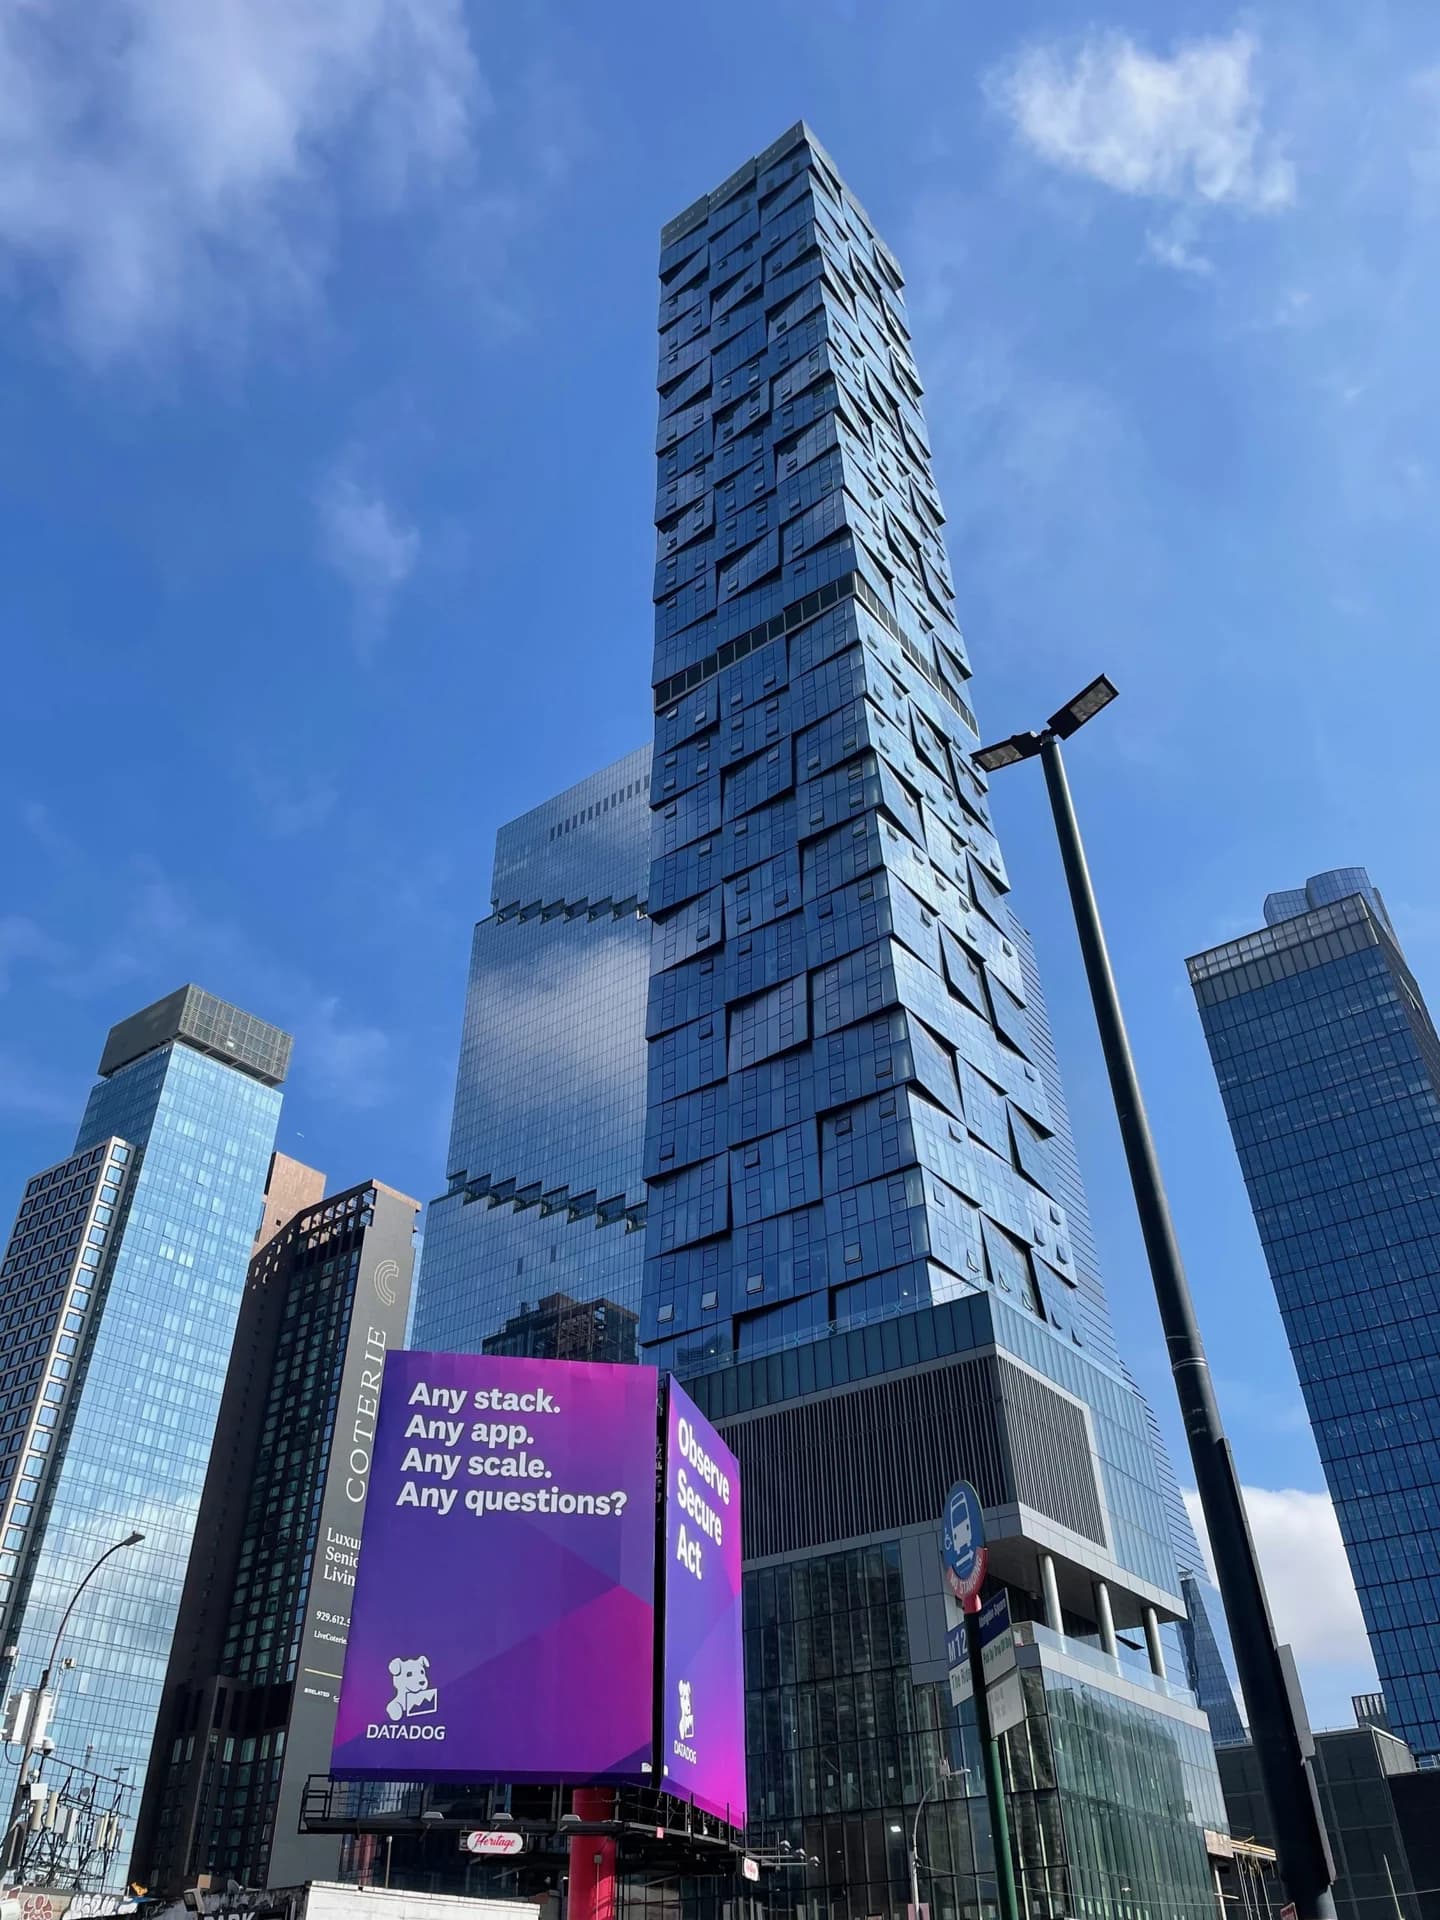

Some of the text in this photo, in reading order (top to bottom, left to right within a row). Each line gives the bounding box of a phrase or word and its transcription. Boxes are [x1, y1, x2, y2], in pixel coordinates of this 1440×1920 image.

[346, 1326, 387, 1502] COTERIE
[408, 1382, 561, 1414] Any stack.
[404, 1414, 534, 1450] Any app.
[400, 1447, 552, 1480] Any scale.
[678, 1417, 730, 1505] Observe
[396, 1481, 627, 1516] Any questions?
[677, 1468, 722, 1546] Secure
[677, 1523, 702, 1580] Act
[947, 1628, 968, 1664] M12
[366, 1724, 446, 1741] DATADOG
[673, 1740, 697, 1765] DATADOG
[472, 1832, 515, 1852] Heritage
